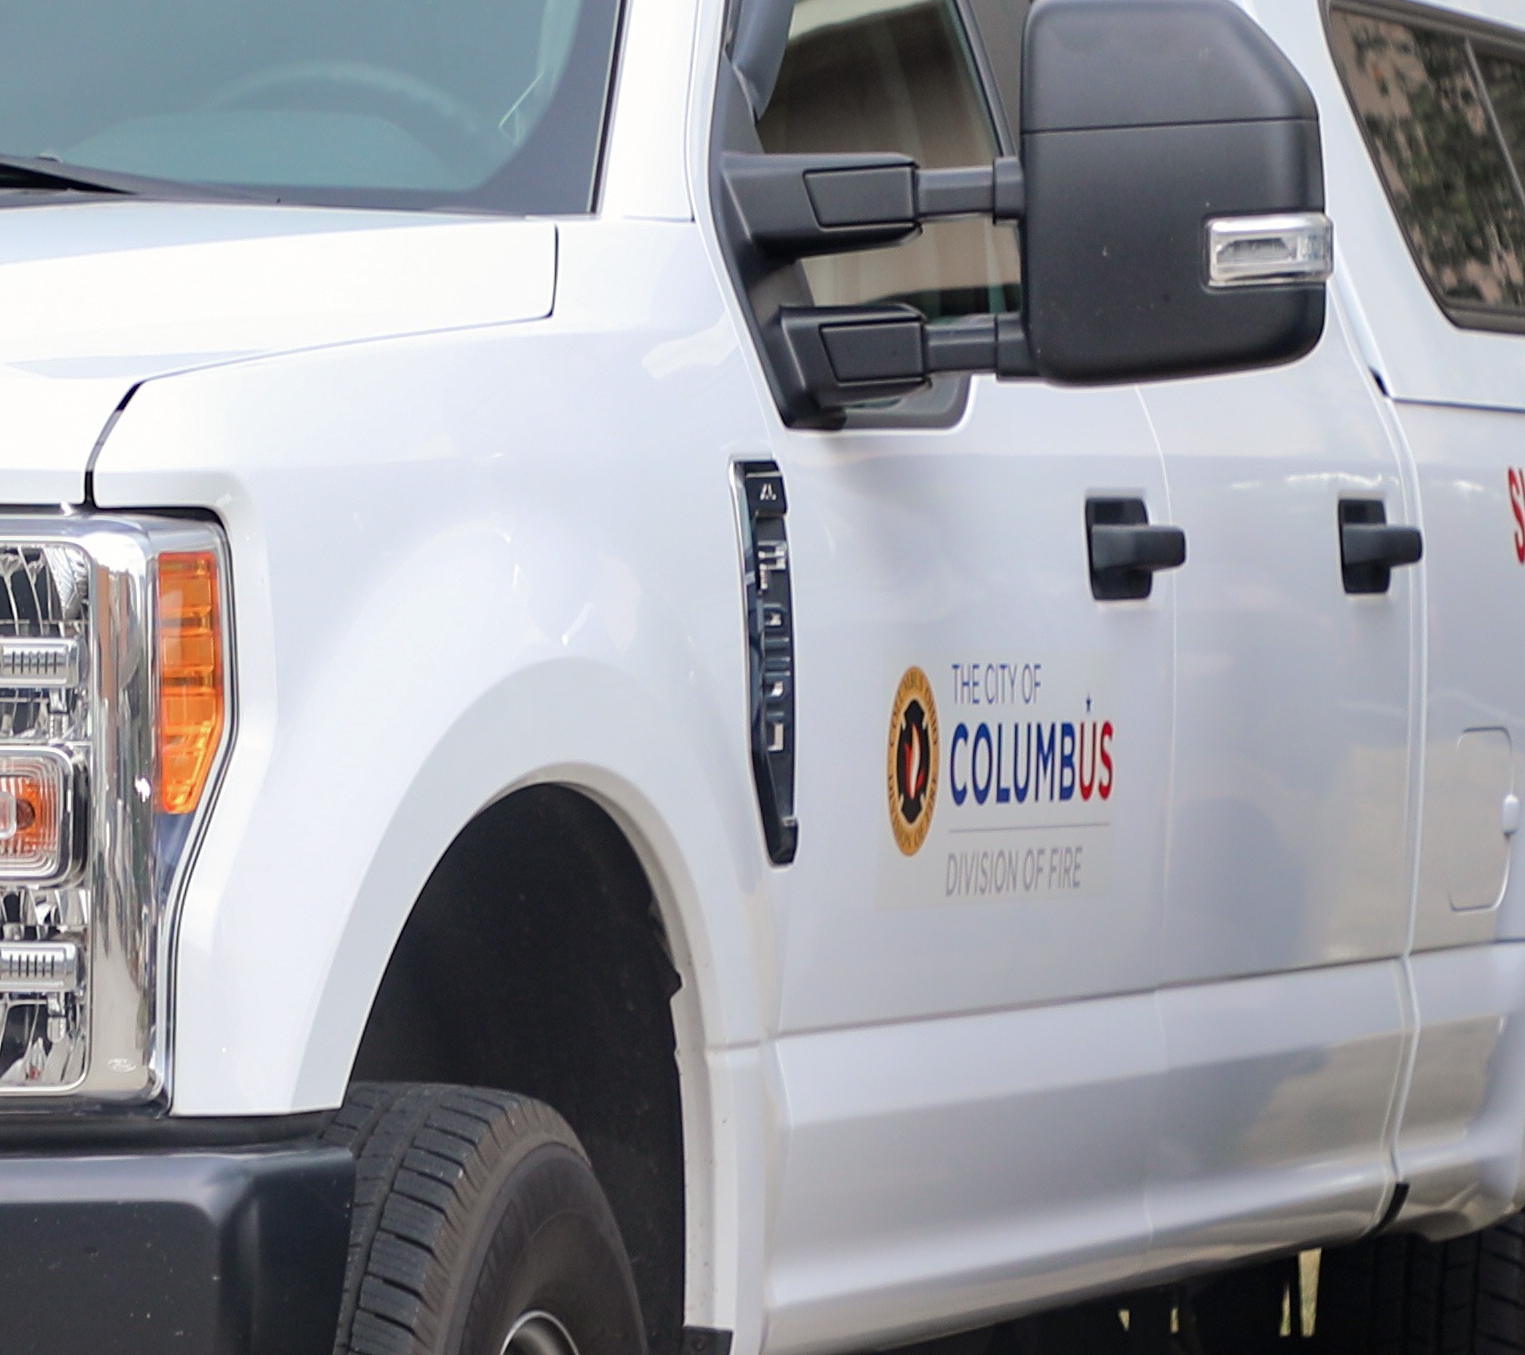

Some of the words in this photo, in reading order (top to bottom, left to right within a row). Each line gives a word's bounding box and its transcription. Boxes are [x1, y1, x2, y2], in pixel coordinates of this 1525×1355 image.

[952, 663, 980, 705] THE
[985, 663, 1018, 705] CITY
[1022, 663, 1042, 705] OF
[950, 720, 1114, 806] COLUMBUS
[946, 849, 1018, 897] DIVISION
[1023, 848, 1045, 892] OF
[1049, 846, 1083, 889] FIRE
